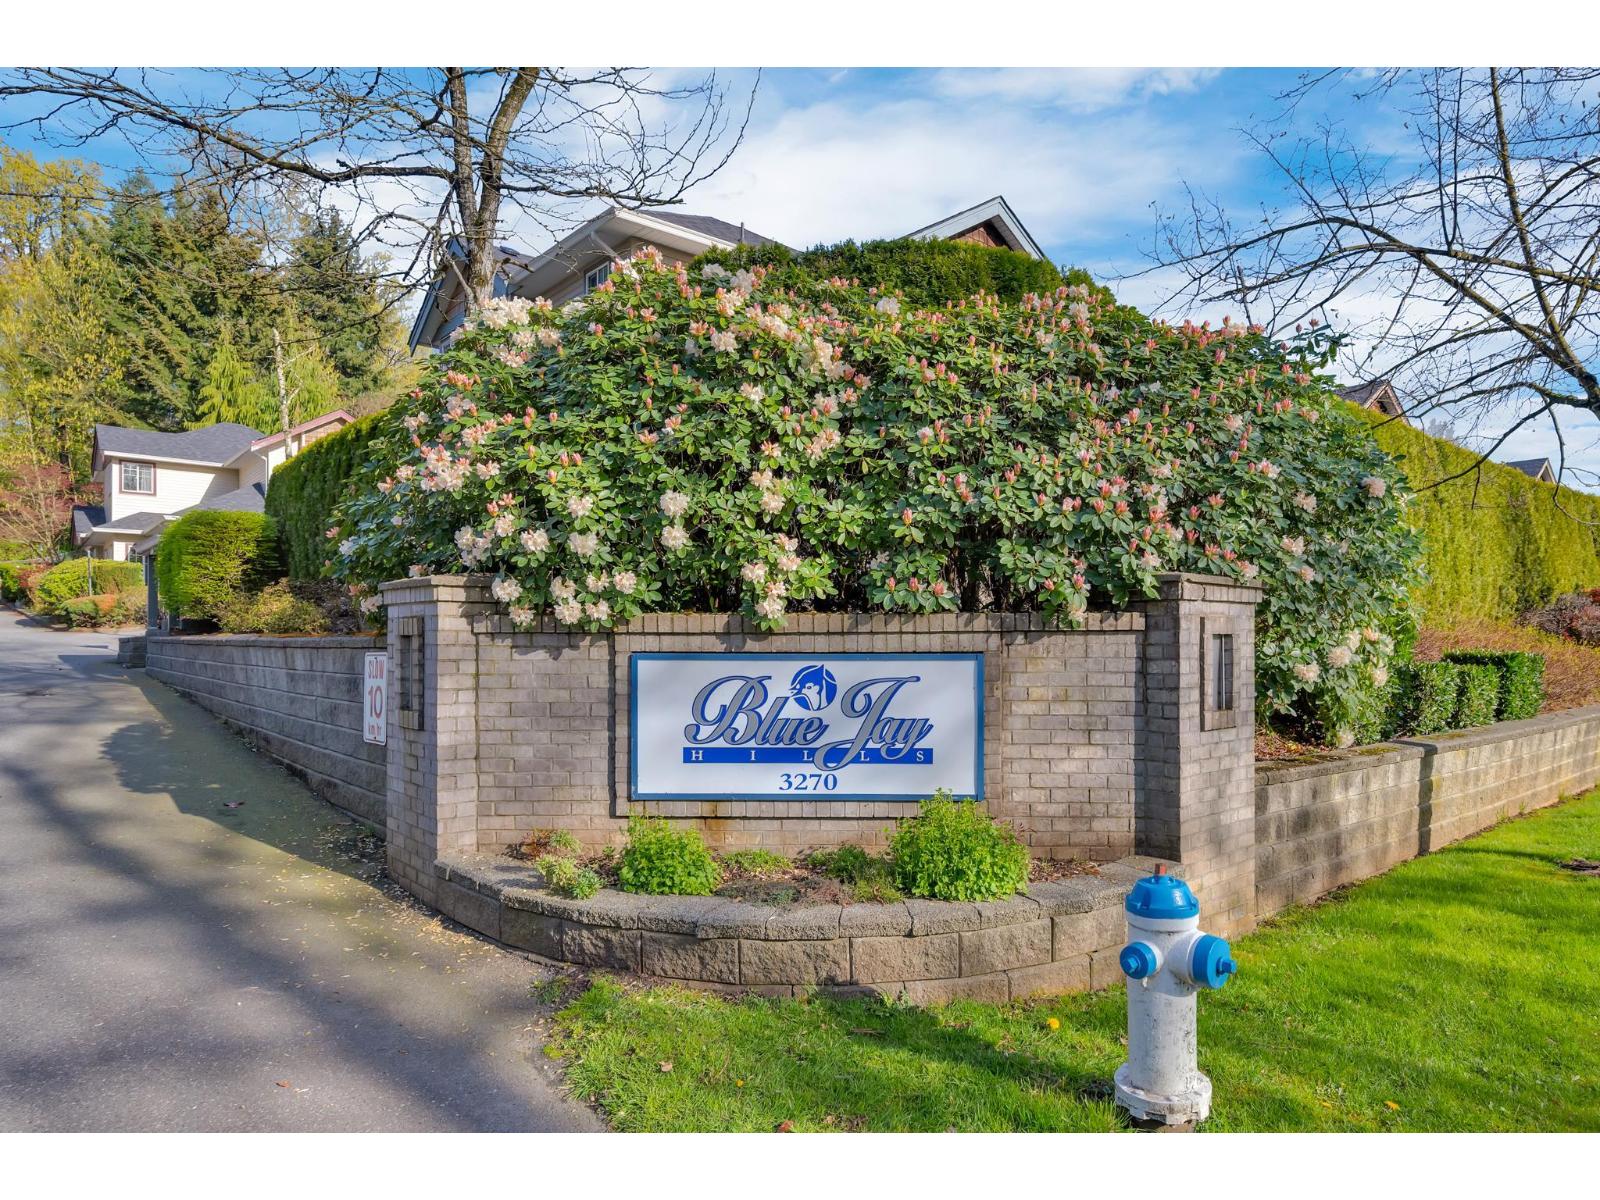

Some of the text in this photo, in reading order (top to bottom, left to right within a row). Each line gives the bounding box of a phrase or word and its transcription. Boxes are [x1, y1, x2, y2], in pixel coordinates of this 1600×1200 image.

[368, 659, 384, 679] SLOW
[368, 685, 383, 719] 10
[684, 675, 934, 771] Blue Jay
[691, 750, 925, 762] HILLS
[779, 773, 838, 791] 3270
